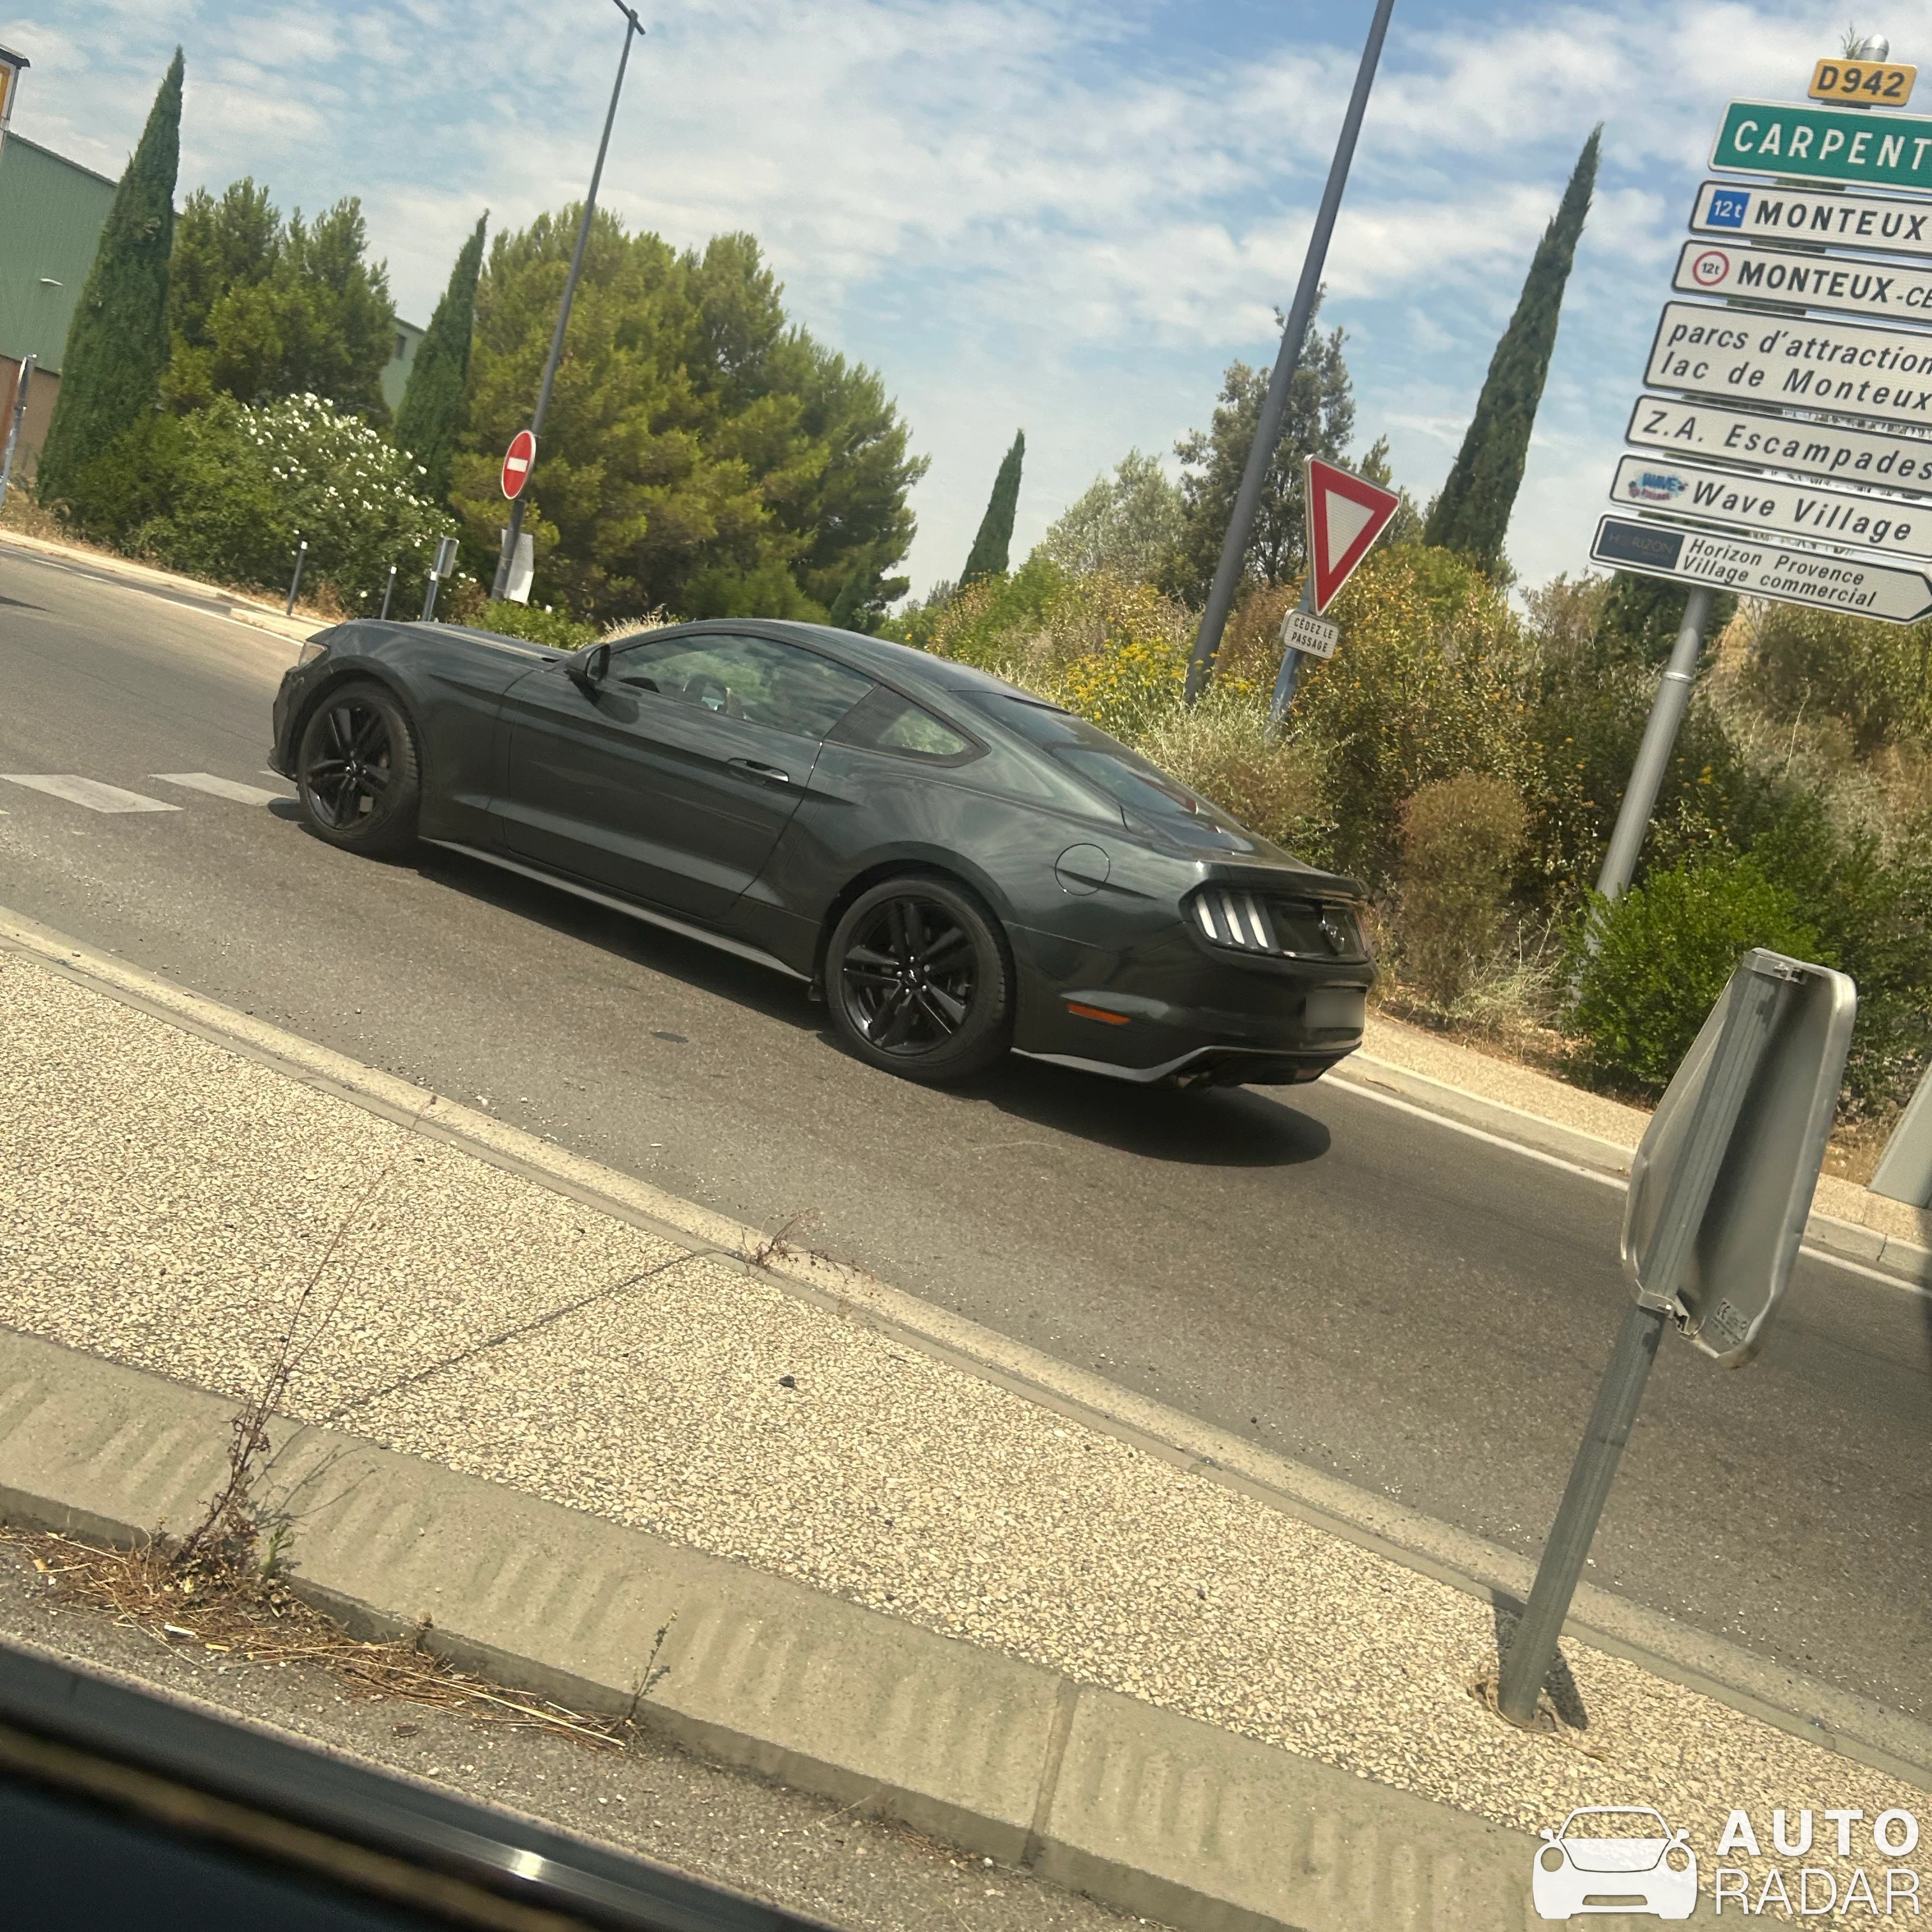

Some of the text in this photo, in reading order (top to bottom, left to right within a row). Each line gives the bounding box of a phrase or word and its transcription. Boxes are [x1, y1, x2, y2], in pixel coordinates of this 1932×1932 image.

[1817, 67, 1905, 97] D942
[1733, 119, 1932, 170] CARPENT
[1715, 200, 1928, 241] 12t MONTEUX
[1701, 262, 1721, 275] 12t
[1667, 324, 1749, 349] parcs
[1660, 351, 1932, 410] lac de Monteux
[1643, 410, 1932, 480] Z.A. Escampades
[1693, 480, 1912, 543] Wave Village
[1683, 555, 1877, 607] Village commercial
[1689, 538, 1864, 585] Horizon Provence
[1291, 632, 1328, 652] PASSAGE
[1323, 629, 1333, 639] LE
